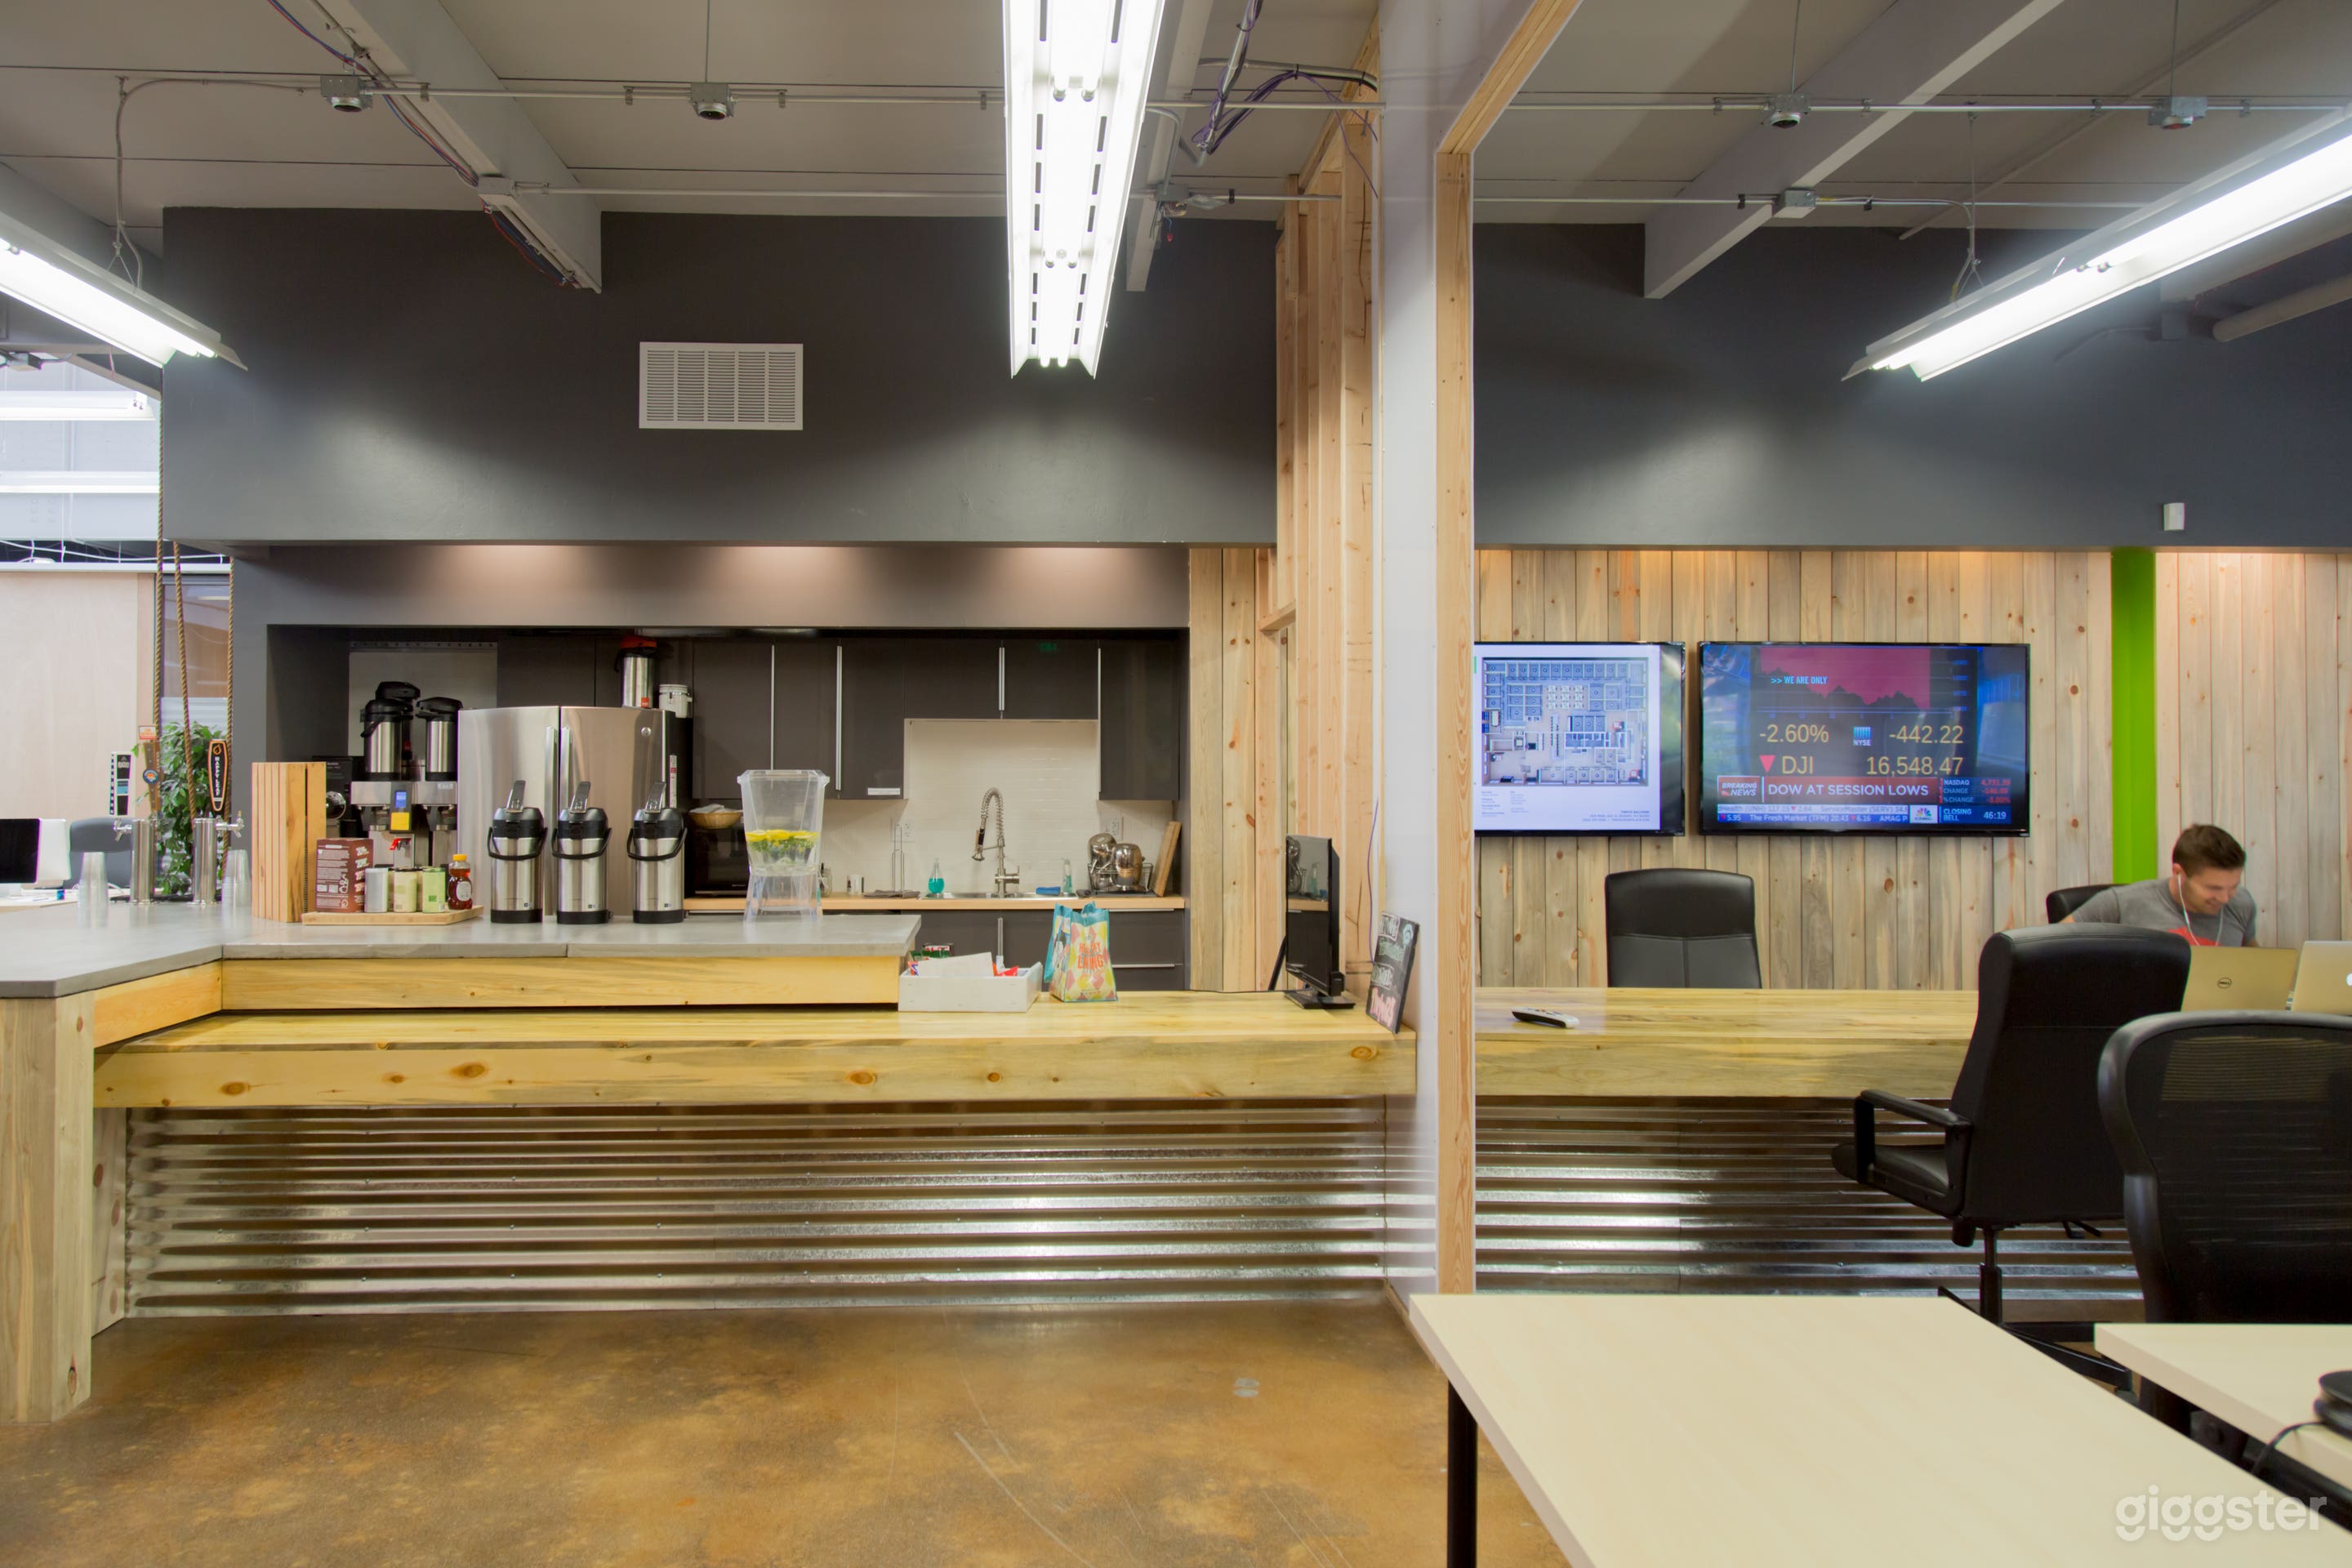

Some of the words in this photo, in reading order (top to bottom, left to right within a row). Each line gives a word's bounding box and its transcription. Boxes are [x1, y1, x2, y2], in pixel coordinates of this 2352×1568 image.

[1784, 676, 1794, 684] WE
[1796, 676, 1809, 684] ARE
[1811, 676, 1828, 684] ONLY
[1759, 724, 1830, 743] -2.60%
[1889, 724, 1964, 744] -442.22
[1782, 755, 1814, 775] DJI
[1866, 756, 1964, 777] 16,548.47
[1768, 784, 1802, 795] DOW
[1806, 784, 1824, 795] AT
[1828, 784, 1885, 795] SESSION
[1888, 784, 1929, 795] LOWS
[1983, 811, 2007, 820] 46:19
